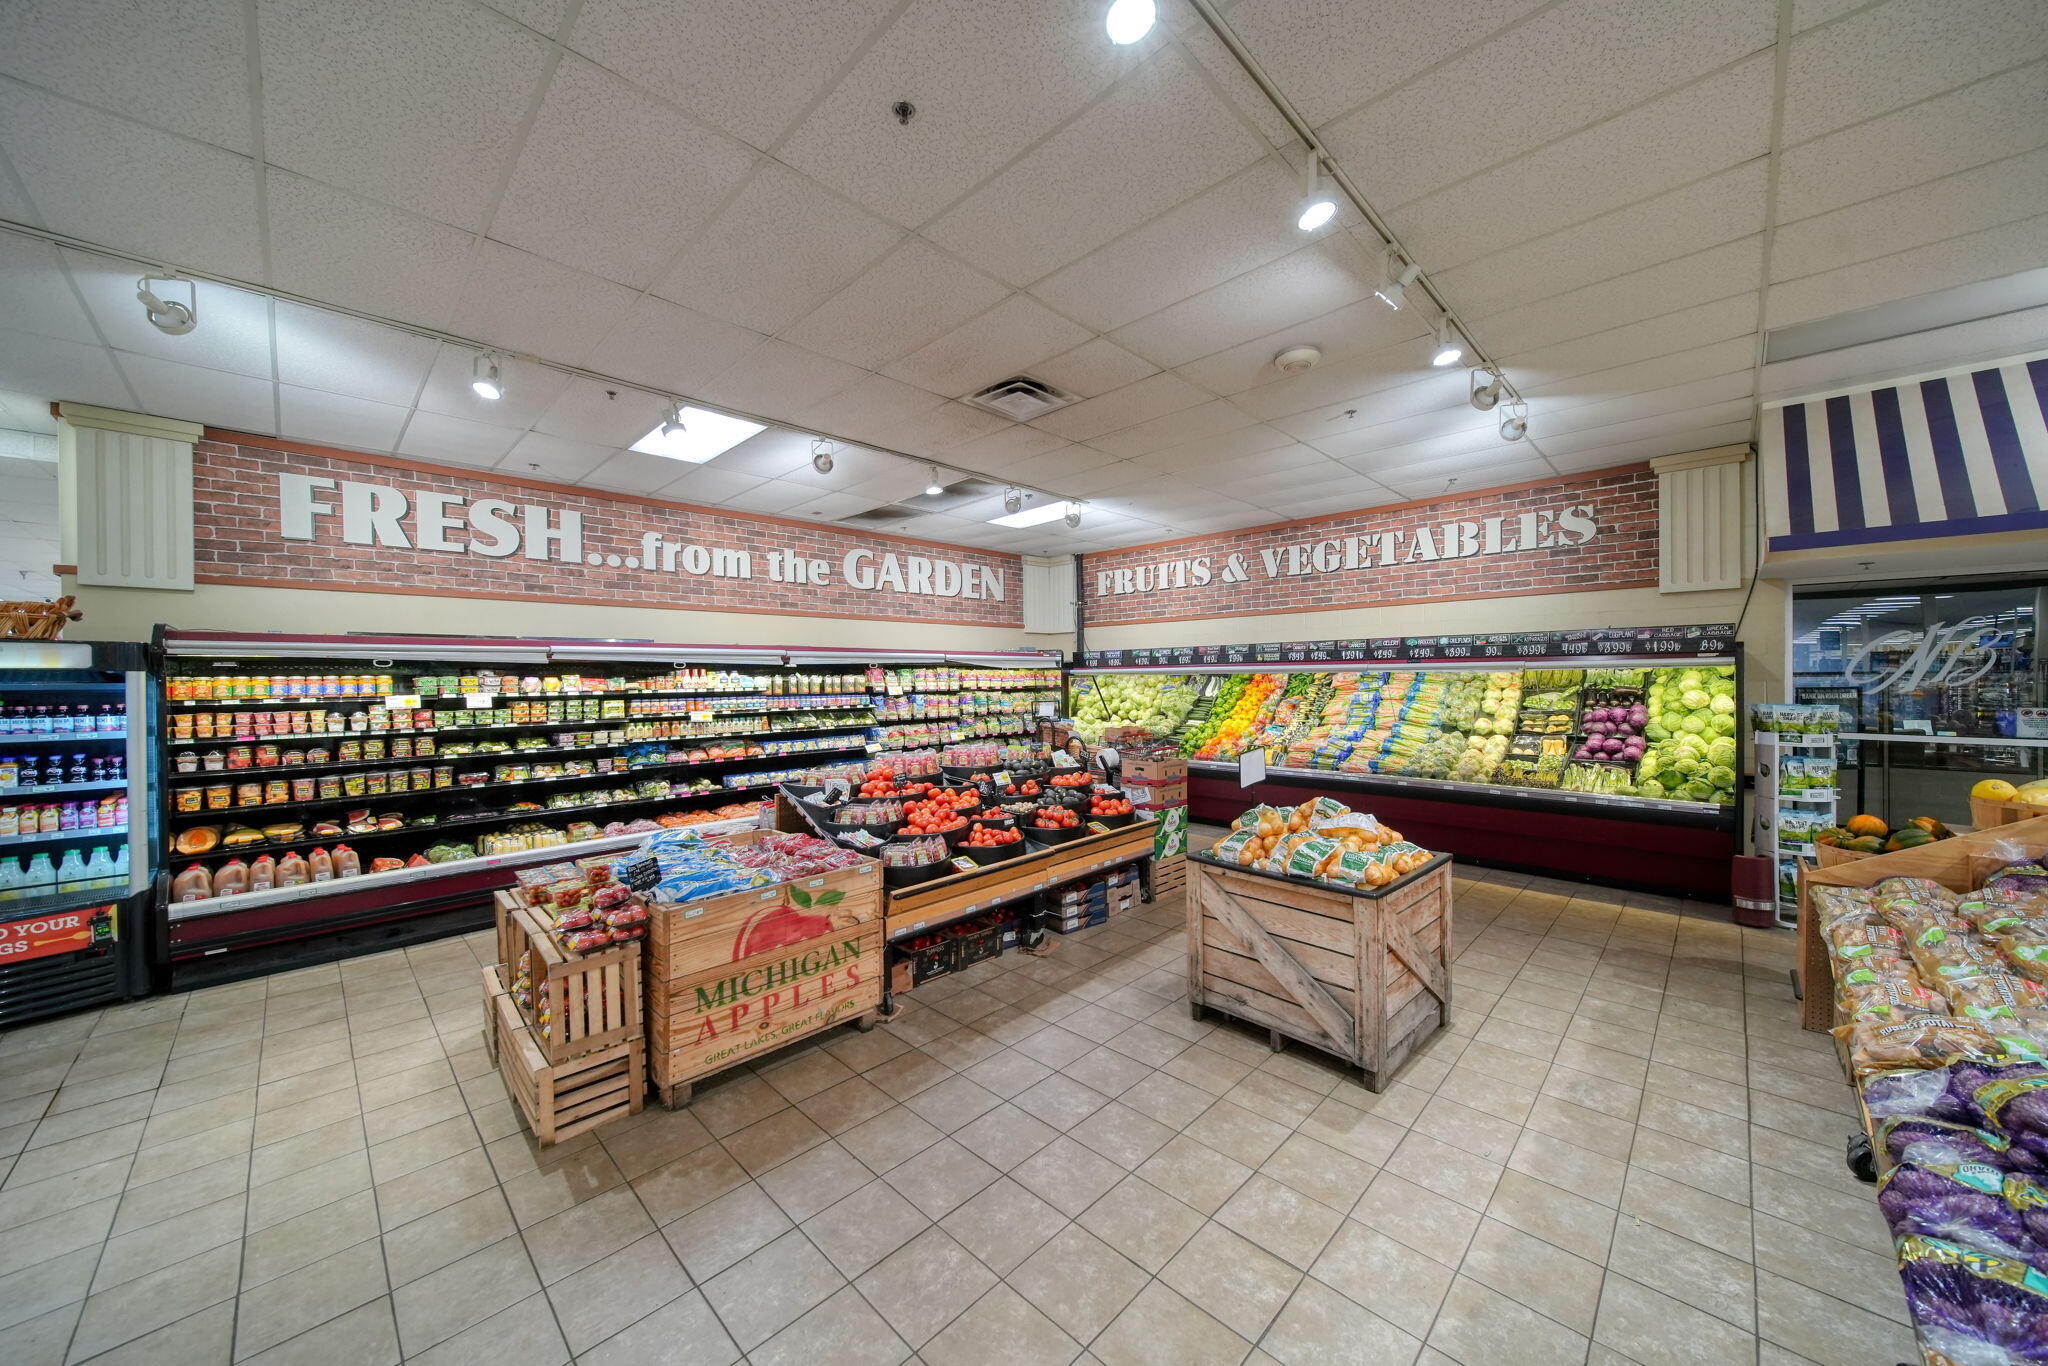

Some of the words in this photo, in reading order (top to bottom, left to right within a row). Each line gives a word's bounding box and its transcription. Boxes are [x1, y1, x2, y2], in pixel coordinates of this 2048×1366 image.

[767, 549, 830, 586] the
[843, 548, 1006, 602] GARDEN
[1096, 556, 1213, 597] FRUITS
[1221, 551, 1249, 584] &
[1259, 504, 1598, 579] VEGETABLES
[13, 915, 81, 937] YOUR
[694, 937, 863, 1014] MICHIGAN
[694, 964, 862, 1046] APPLES
[704, 1044, 741, 1065] GREAT
[781, 1016, 813, 1036] GREAT
[812, 999, 856, 1023] FLAVORS
